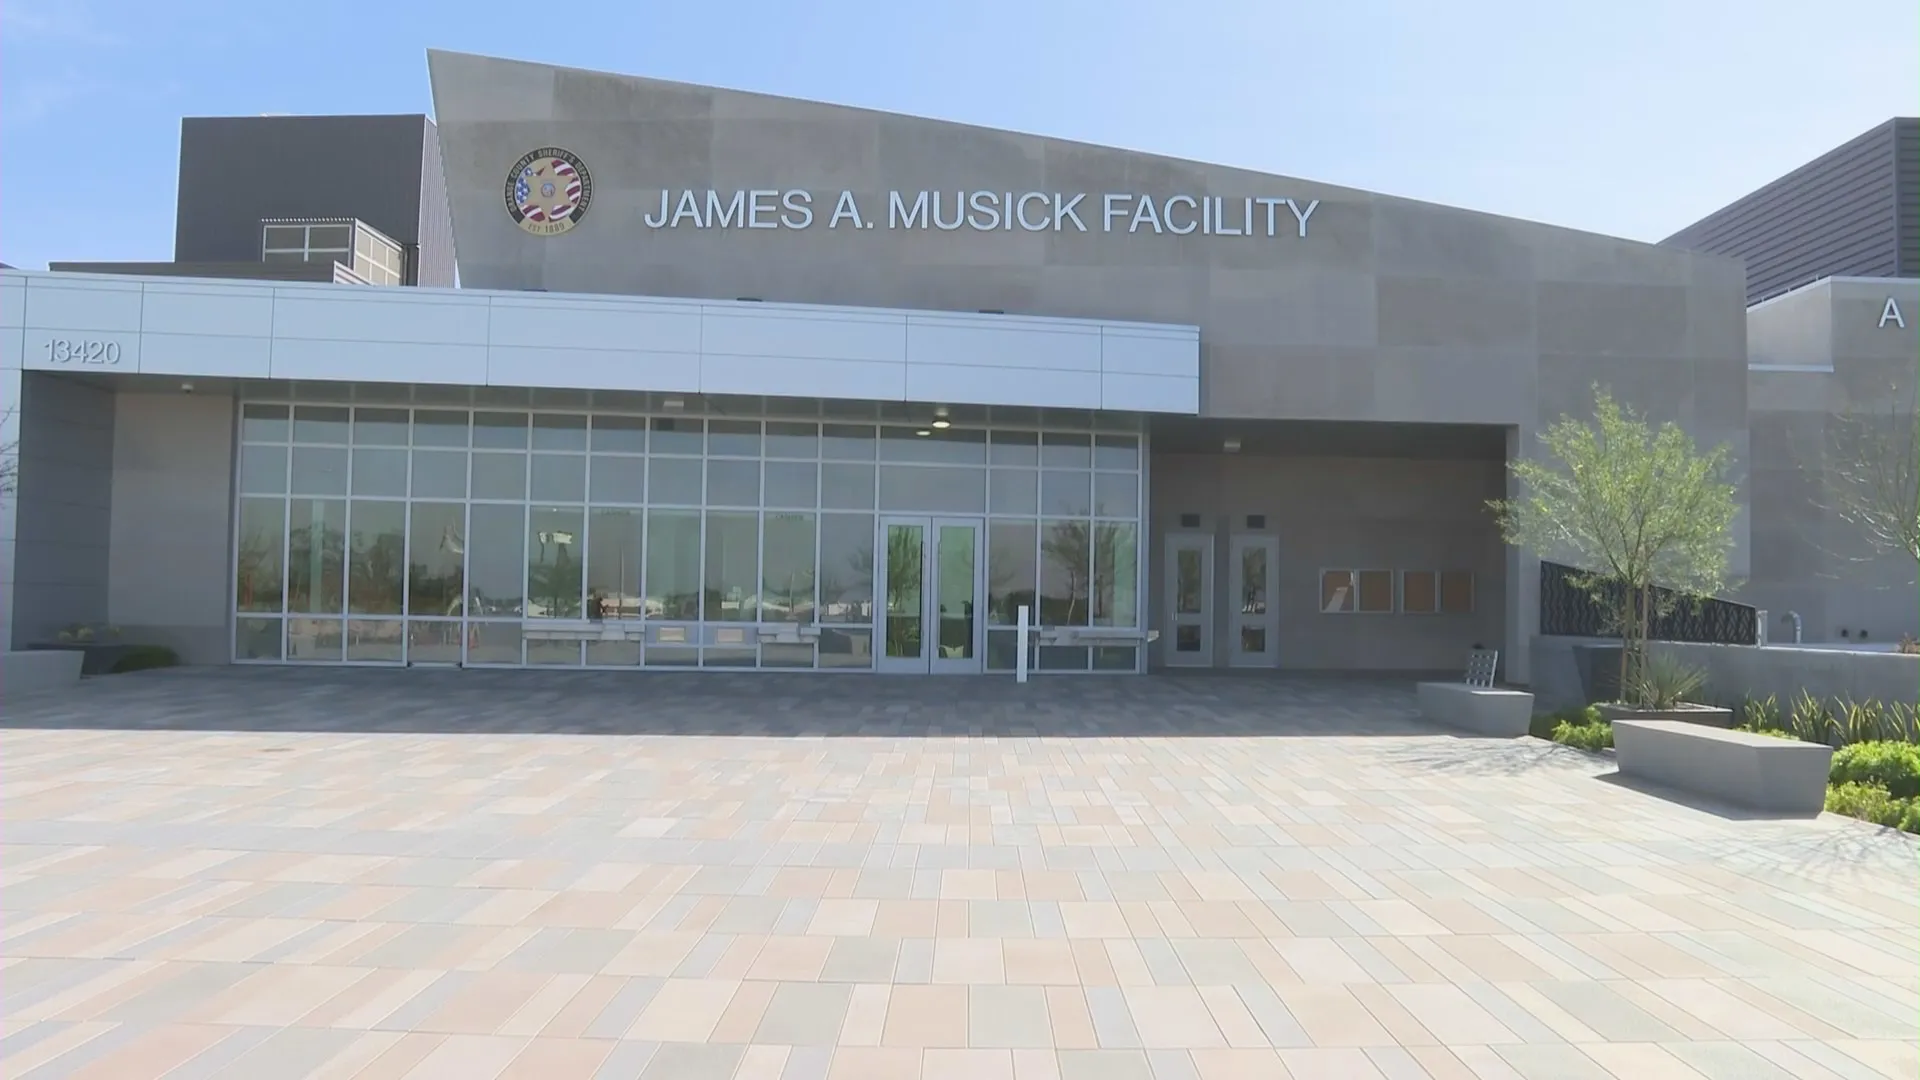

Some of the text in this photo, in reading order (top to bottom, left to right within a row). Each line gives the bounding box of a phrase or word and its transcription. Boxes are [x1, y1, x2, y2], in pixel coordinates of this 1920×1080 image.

[510, 154, 535, 178] COUNTY
[537, 149, 576, 165] SHERIFF'S
[574, 162, 592, 212] DEPARTMENT
[644, 189, 1320, 238] JAMES A. MUSICK FACILITY
[1878, 297, 1905, 328] A
[44, 339, 121, 364] 13420
